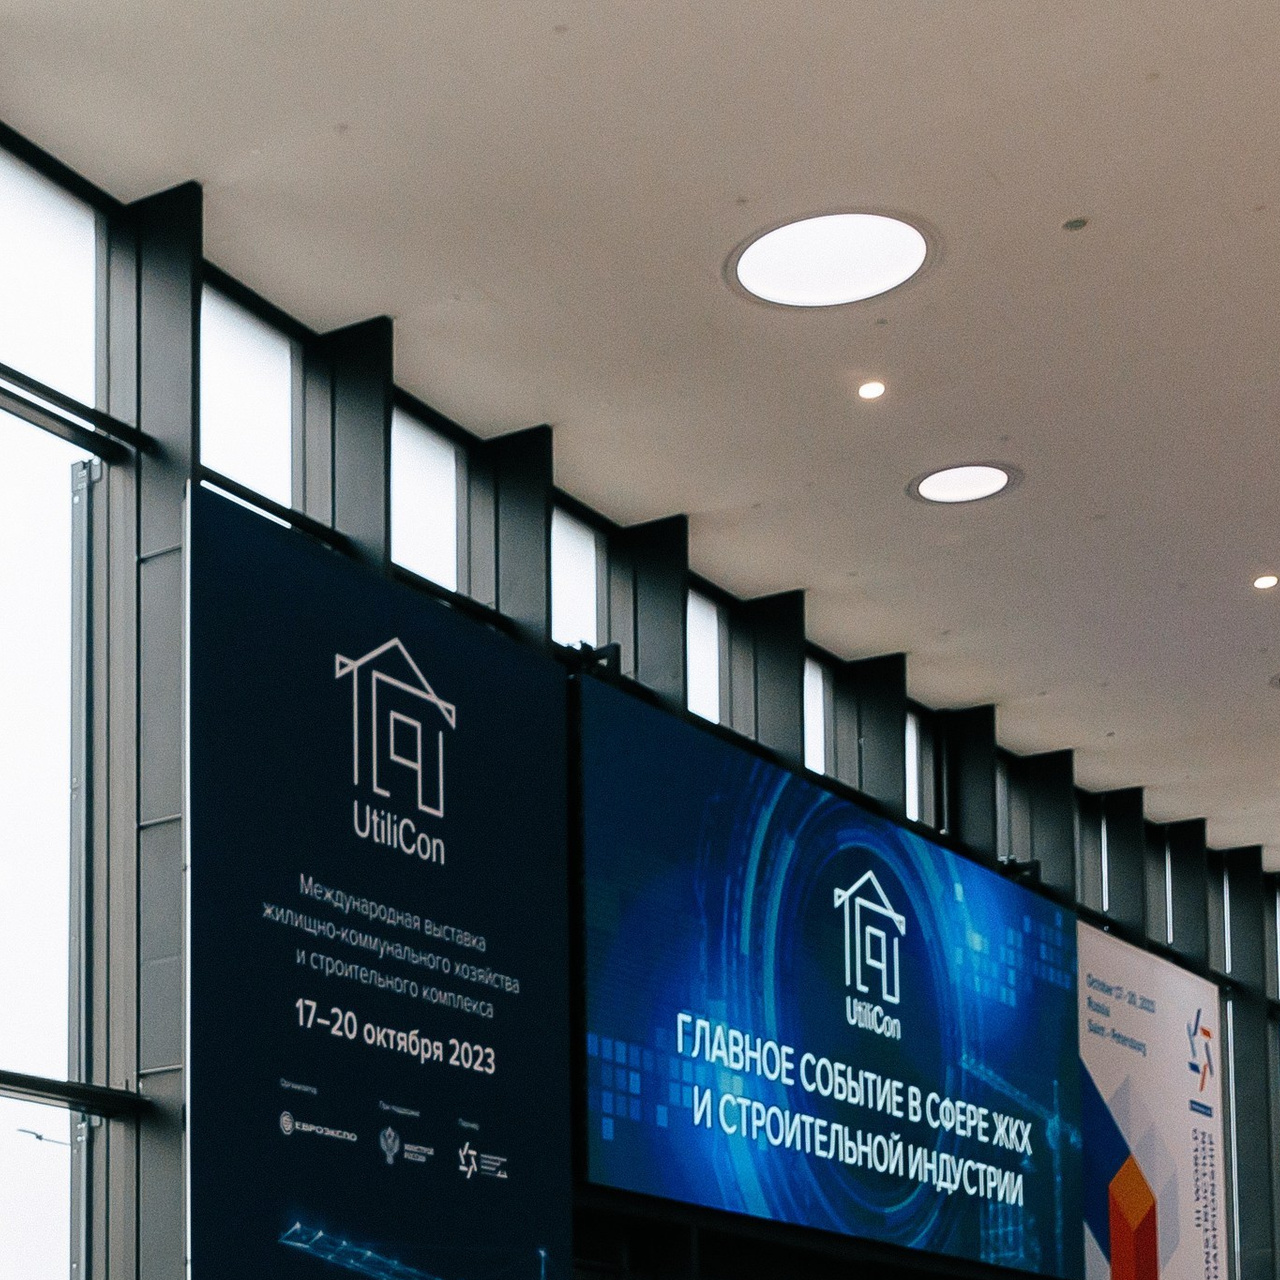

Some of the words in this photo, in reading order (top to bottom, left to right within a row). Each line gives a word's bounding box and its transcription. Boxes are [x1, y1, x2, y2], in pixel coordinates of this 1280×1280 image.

[353, 800, 445, 865] UtiliCon
[261, 901, 451, 974] жилищно-коммунального
[453, 961, 520, 994] хозяйства
[299, 872, 421, 931] Международная
[424, 918, 487, 952] выставка
[296, 948, 306, 966] и
[310, 952, 419, 998] строительного
[422, 984, 494, 1018] комплекса
[363, 1022, 444, 1064] октября
[448, 1038, 496, 1075] 2023
[676, 1012, 795, 1086] ГЛАВНОЕ
[799, 1052, 904, 1119] СОБЫТИЕ
[907, 1085, 922, 1123] В
[925, 1091, 990, 1144] СФЕРЕ
[992, 1111, 1033, 1156] ЖКХ
[693, 1084, 712, 1130] И
[719, 1093, 904, 1177] СТРОИТЕЛЬНОЙ
[907, 1143, 1025, 1208] ИНДУСТРИИ
